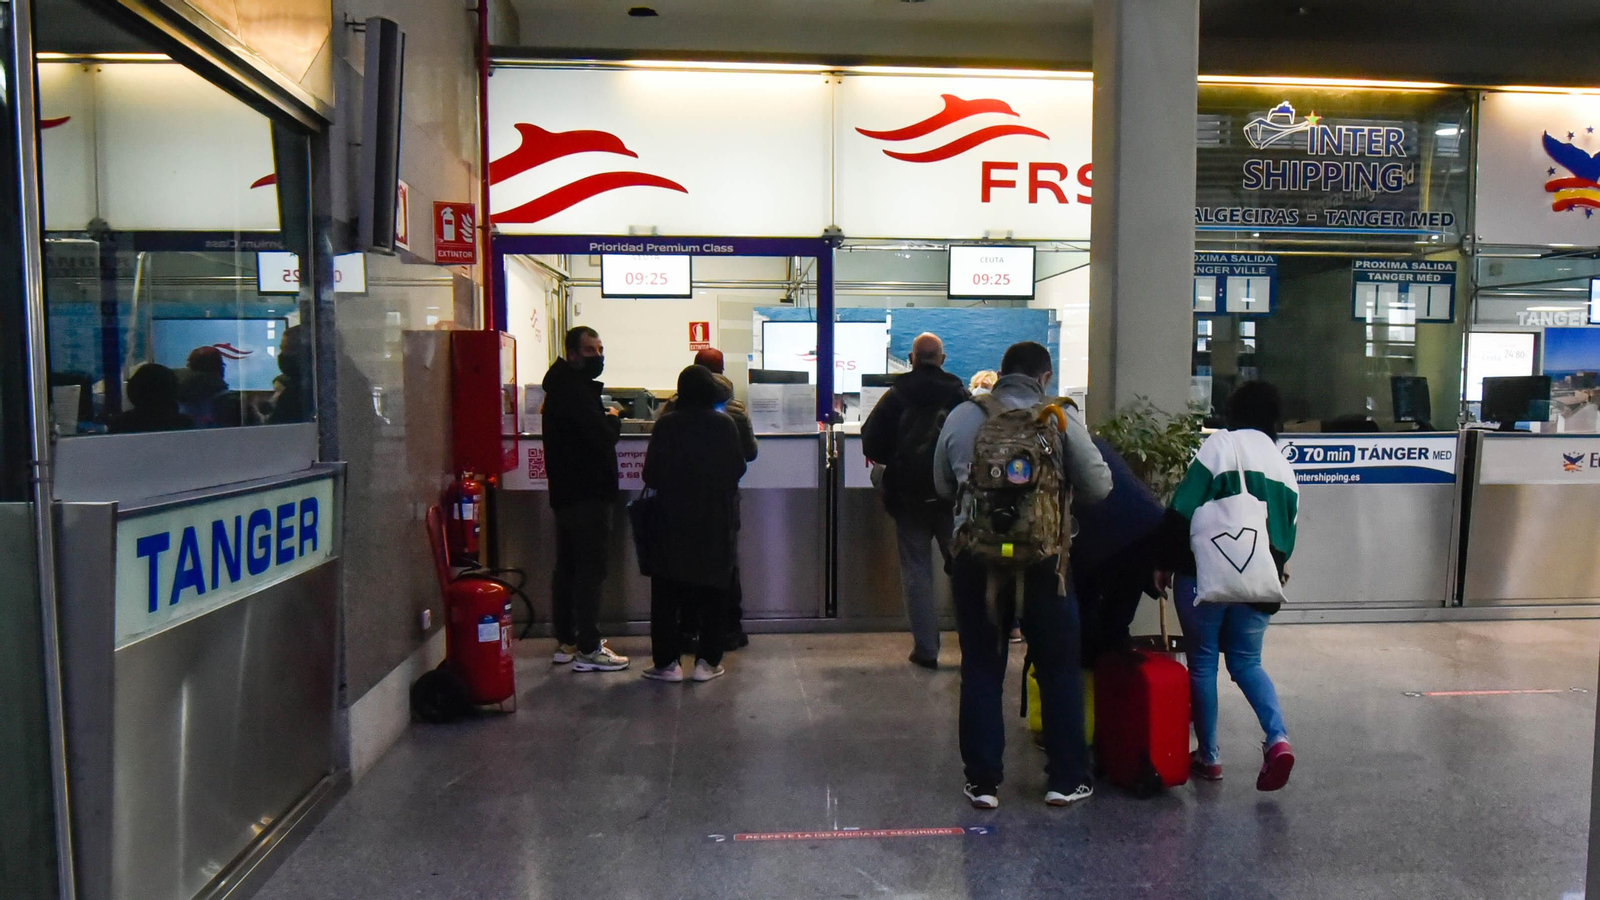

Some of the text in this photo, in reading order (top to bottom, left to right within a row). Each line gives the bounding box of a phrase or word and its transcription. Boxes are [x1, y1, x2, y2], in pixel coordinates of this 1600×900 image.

[1307, 125, 1407, 157] INTER
[1242, 159, 1403, 193] SHIPPING
[1324, 209, 1404, 227] TANGER
[1409, 212, 1454, 227] MED
[589, 242, 734, 253] Prioridad Premium Class
[437, 250, 473, 258] EXTINTOR
[1230, 254, 1274, 262] SALIDA
[1194, 266, 1267, 274] NGER VILLE
[1355, 260, 1453, 271] PROXIMA SALIDA
[625, 272, 668, 285] 09:25
[972, 273, 1011, 285] 09:25
[1367, 272, 1414, 281] TANGER
[835, 360, 857, 370] RS
[1303, 444, 1452, 461] 70 min TÁNGER MED
[137, 496, 319, 613] TANGER
